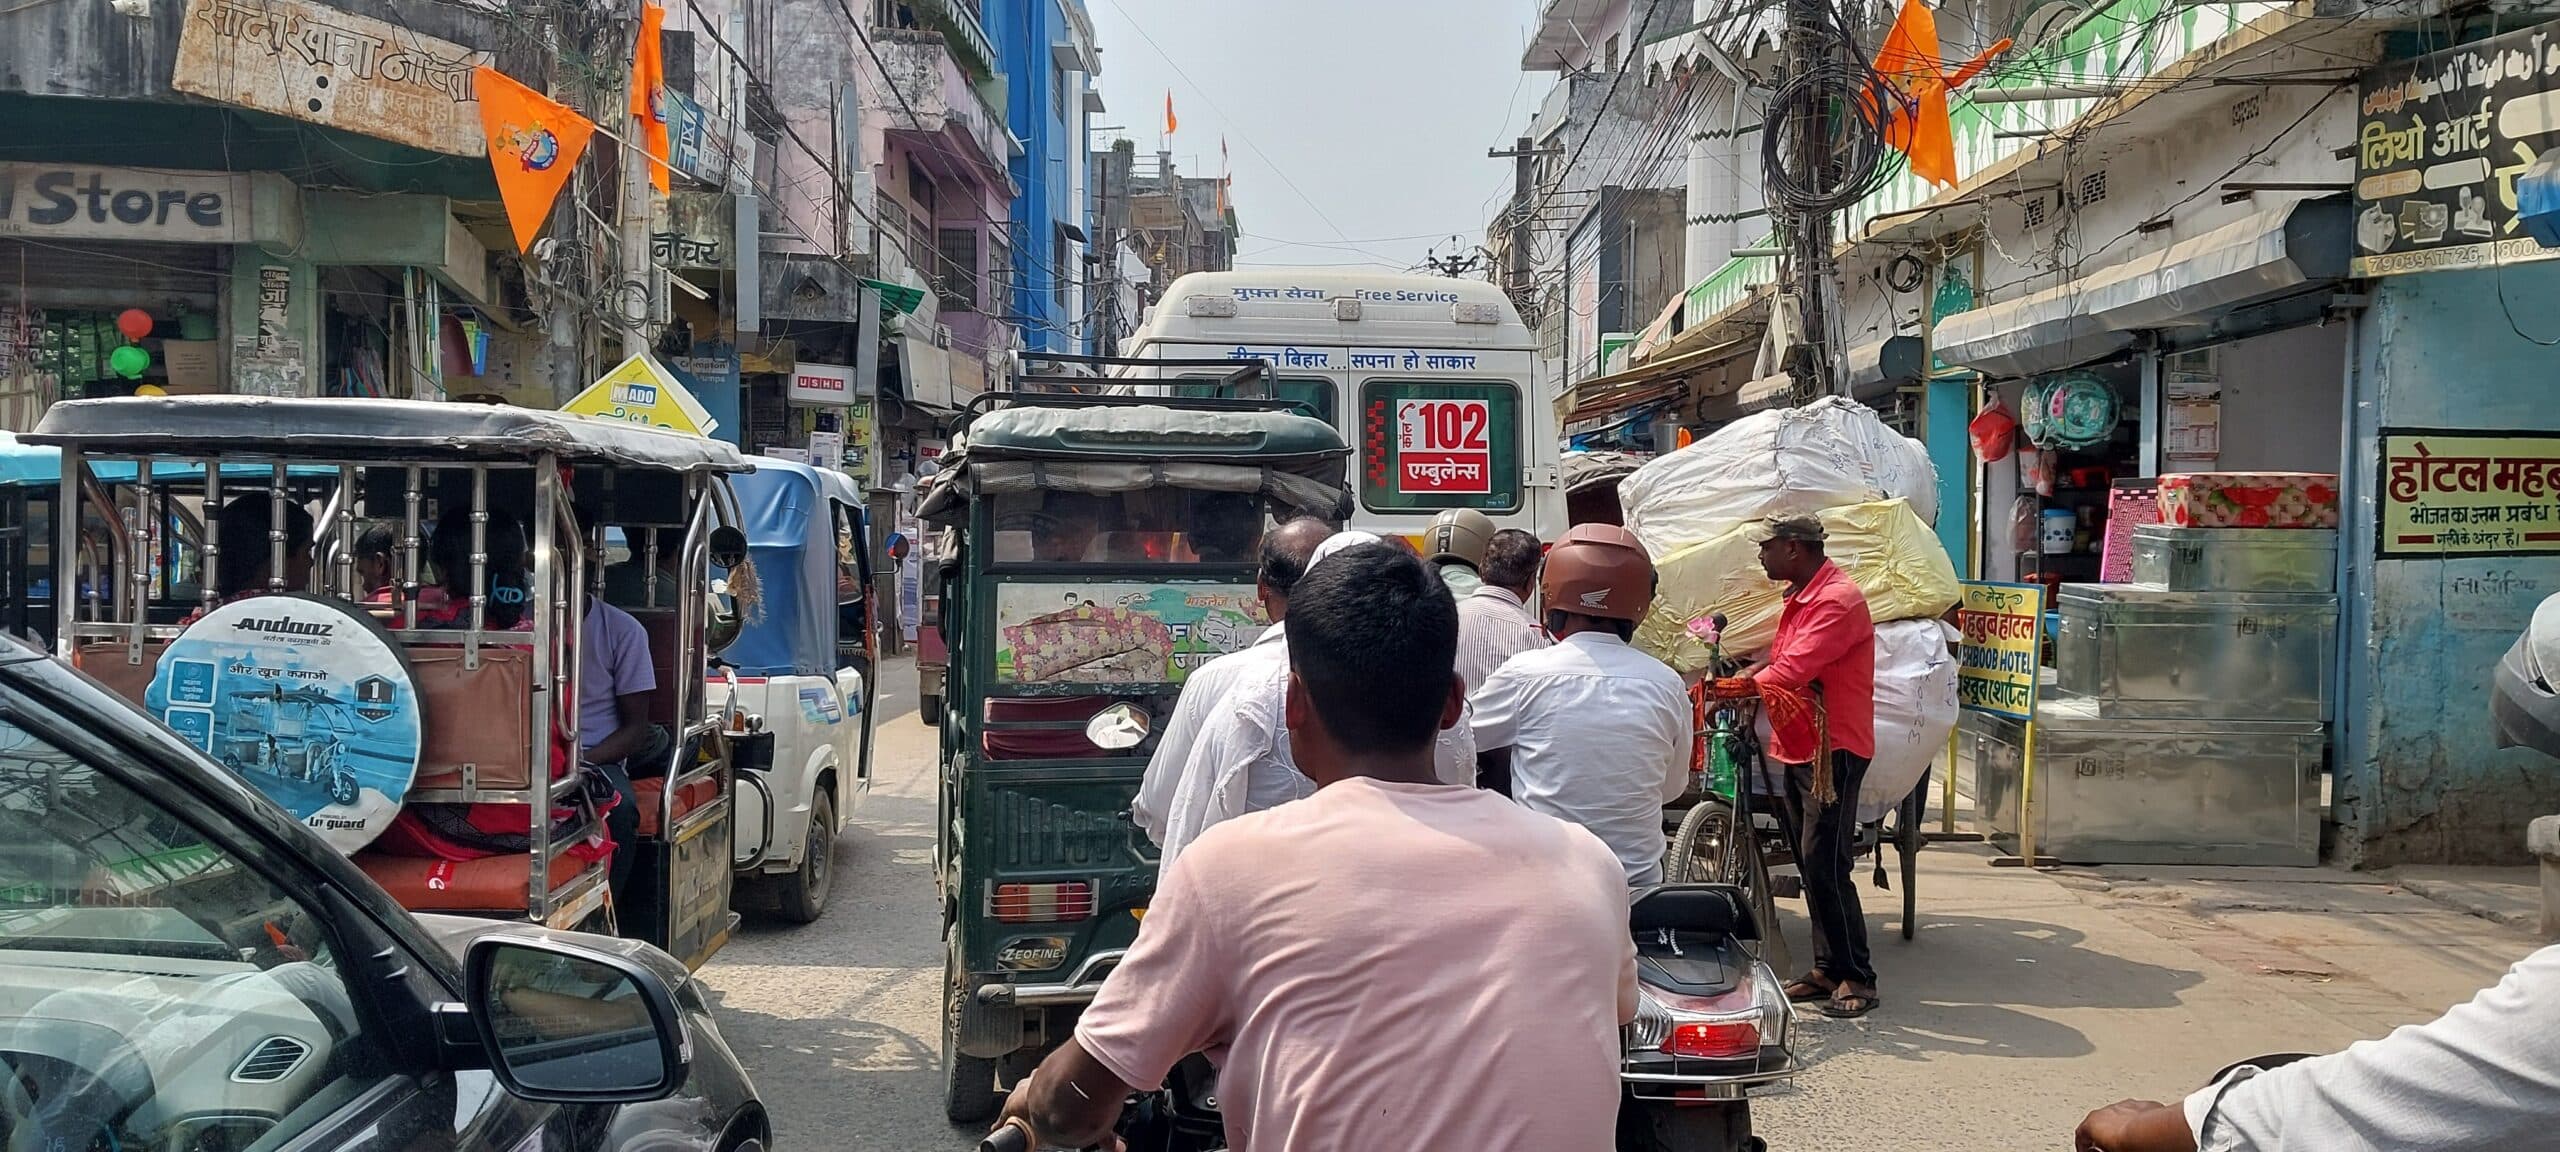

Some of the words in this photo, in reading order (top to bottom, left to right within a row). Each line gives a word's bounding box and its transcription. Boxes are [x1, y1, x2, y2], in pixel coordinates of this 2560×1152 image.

[286, 15, 385, 80] खाना
[28, 171, 222, 227] Store
[1284, 286, 1325, 299] सेवा
[1355, 289, 1392, 301] Free
[1396, 290, 1458, 303] Service
[1351, 354, 1394, 369] सपना
[1403, 350, 1421, 370] हो
[1426, 354, 1476, 370] साकार
[798, 377, 843, 391] USHA
[1418, 402, 1488, 450] 102
[1407, 457, 1481, 486] एम्बुलेन्स
[2389, 441, 2491, 503] होटल
[2410, 502, 2450, 525] भोजन
[2450, 507, 2468, 523] का
[2505, 501, 2550, 523] प्रबंध
[2472, 530, 2500, 549] अंदर
[232, 616, 333, 636] Andaaz
[229, 664, 253, 675] और
[257, 667, 282, 679] खूब
[287, 668, 329, 680] कमाओ
[2000, 649, 2032, 675] HOTEL
[370, 681, 379, 699] 1
[1110, 872, 1153, 889] ZEO
[1004, 948, 1061, 961] ZEOFINE
